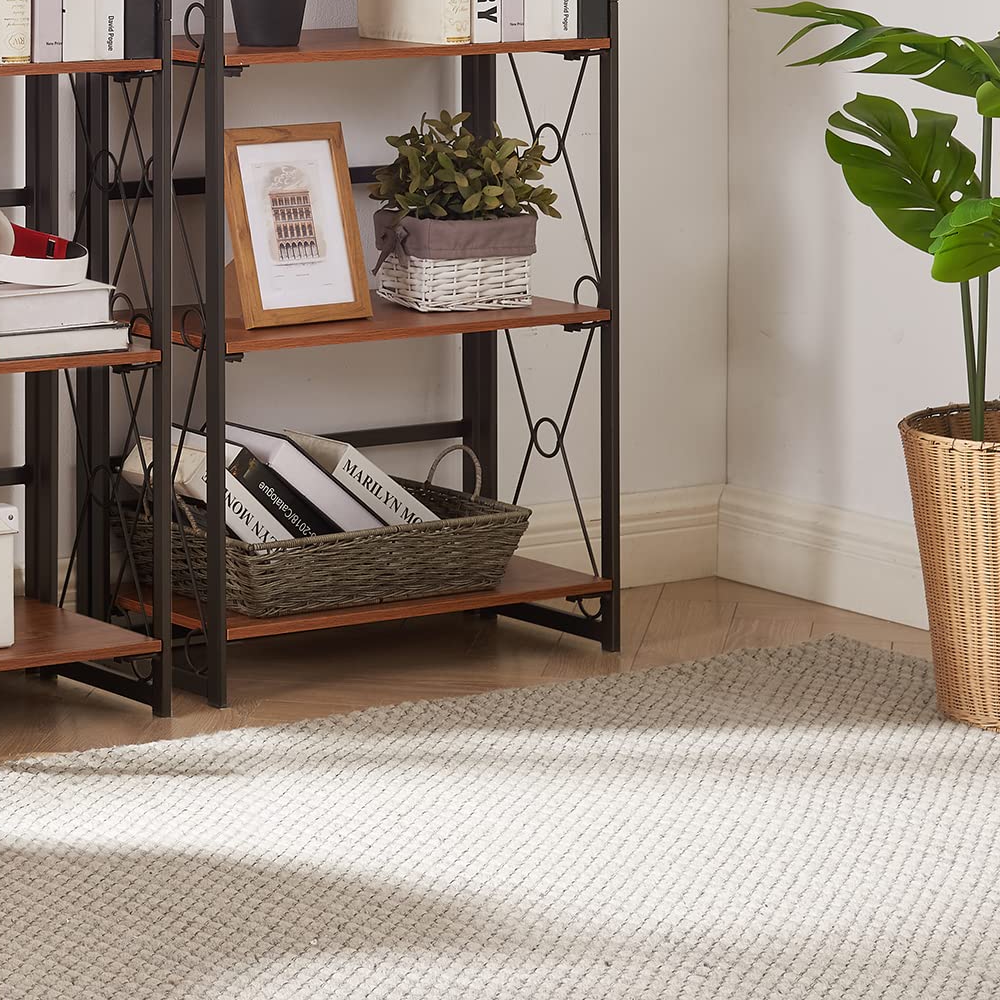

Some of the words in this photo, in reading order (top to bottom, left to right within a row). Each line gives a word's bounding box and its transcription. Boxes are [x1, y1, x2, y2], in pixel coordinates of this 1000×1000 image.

[107, 15, 115, 32] David
[106, 33, 115, 51] Pogue
[342, 459, 403, 512] MARILYN
[398, 506, 424, 524] MO
